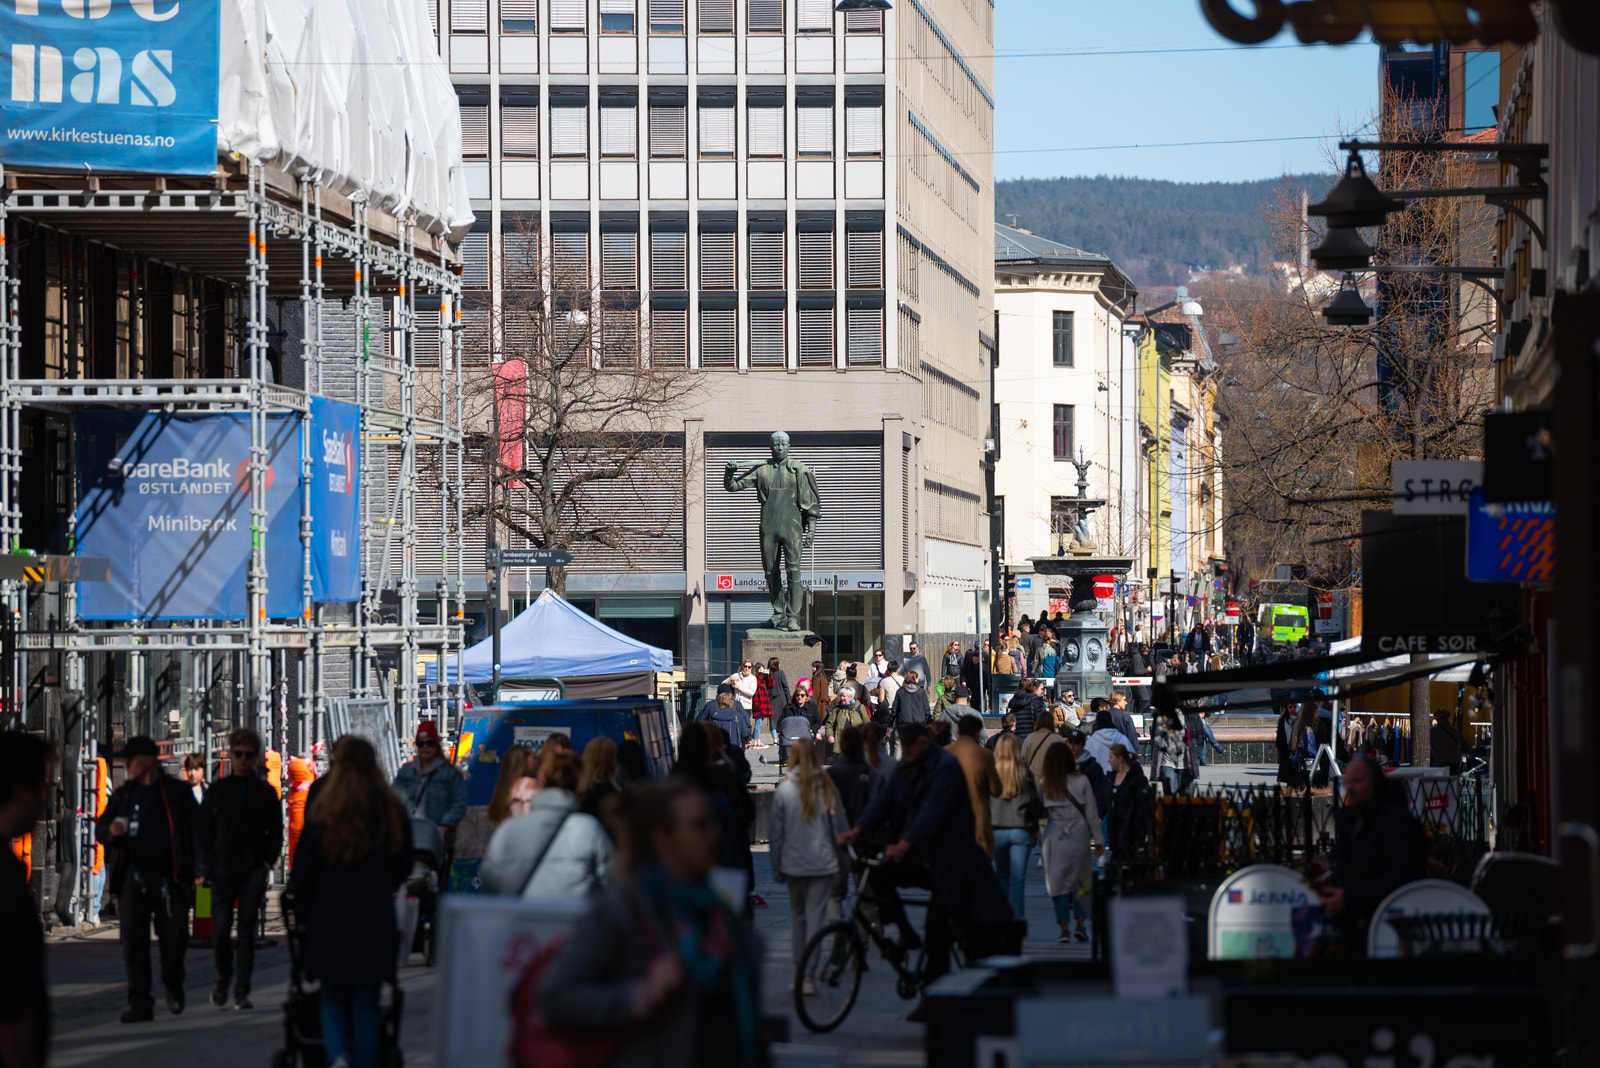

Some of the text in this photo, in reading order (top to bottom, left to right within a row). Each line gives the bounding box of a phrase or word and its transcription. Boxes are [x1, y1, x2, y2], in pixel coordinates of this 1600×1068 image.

[11, 44, 176, 107] nas
[7, 126, 175, 147] www.kirkestuenas.no
[139, 482, 232, 494] ØSTLANDET
[148, 515, 237, 531] Minibank
[1378, 635, 1477, 651] CAFE SØR
